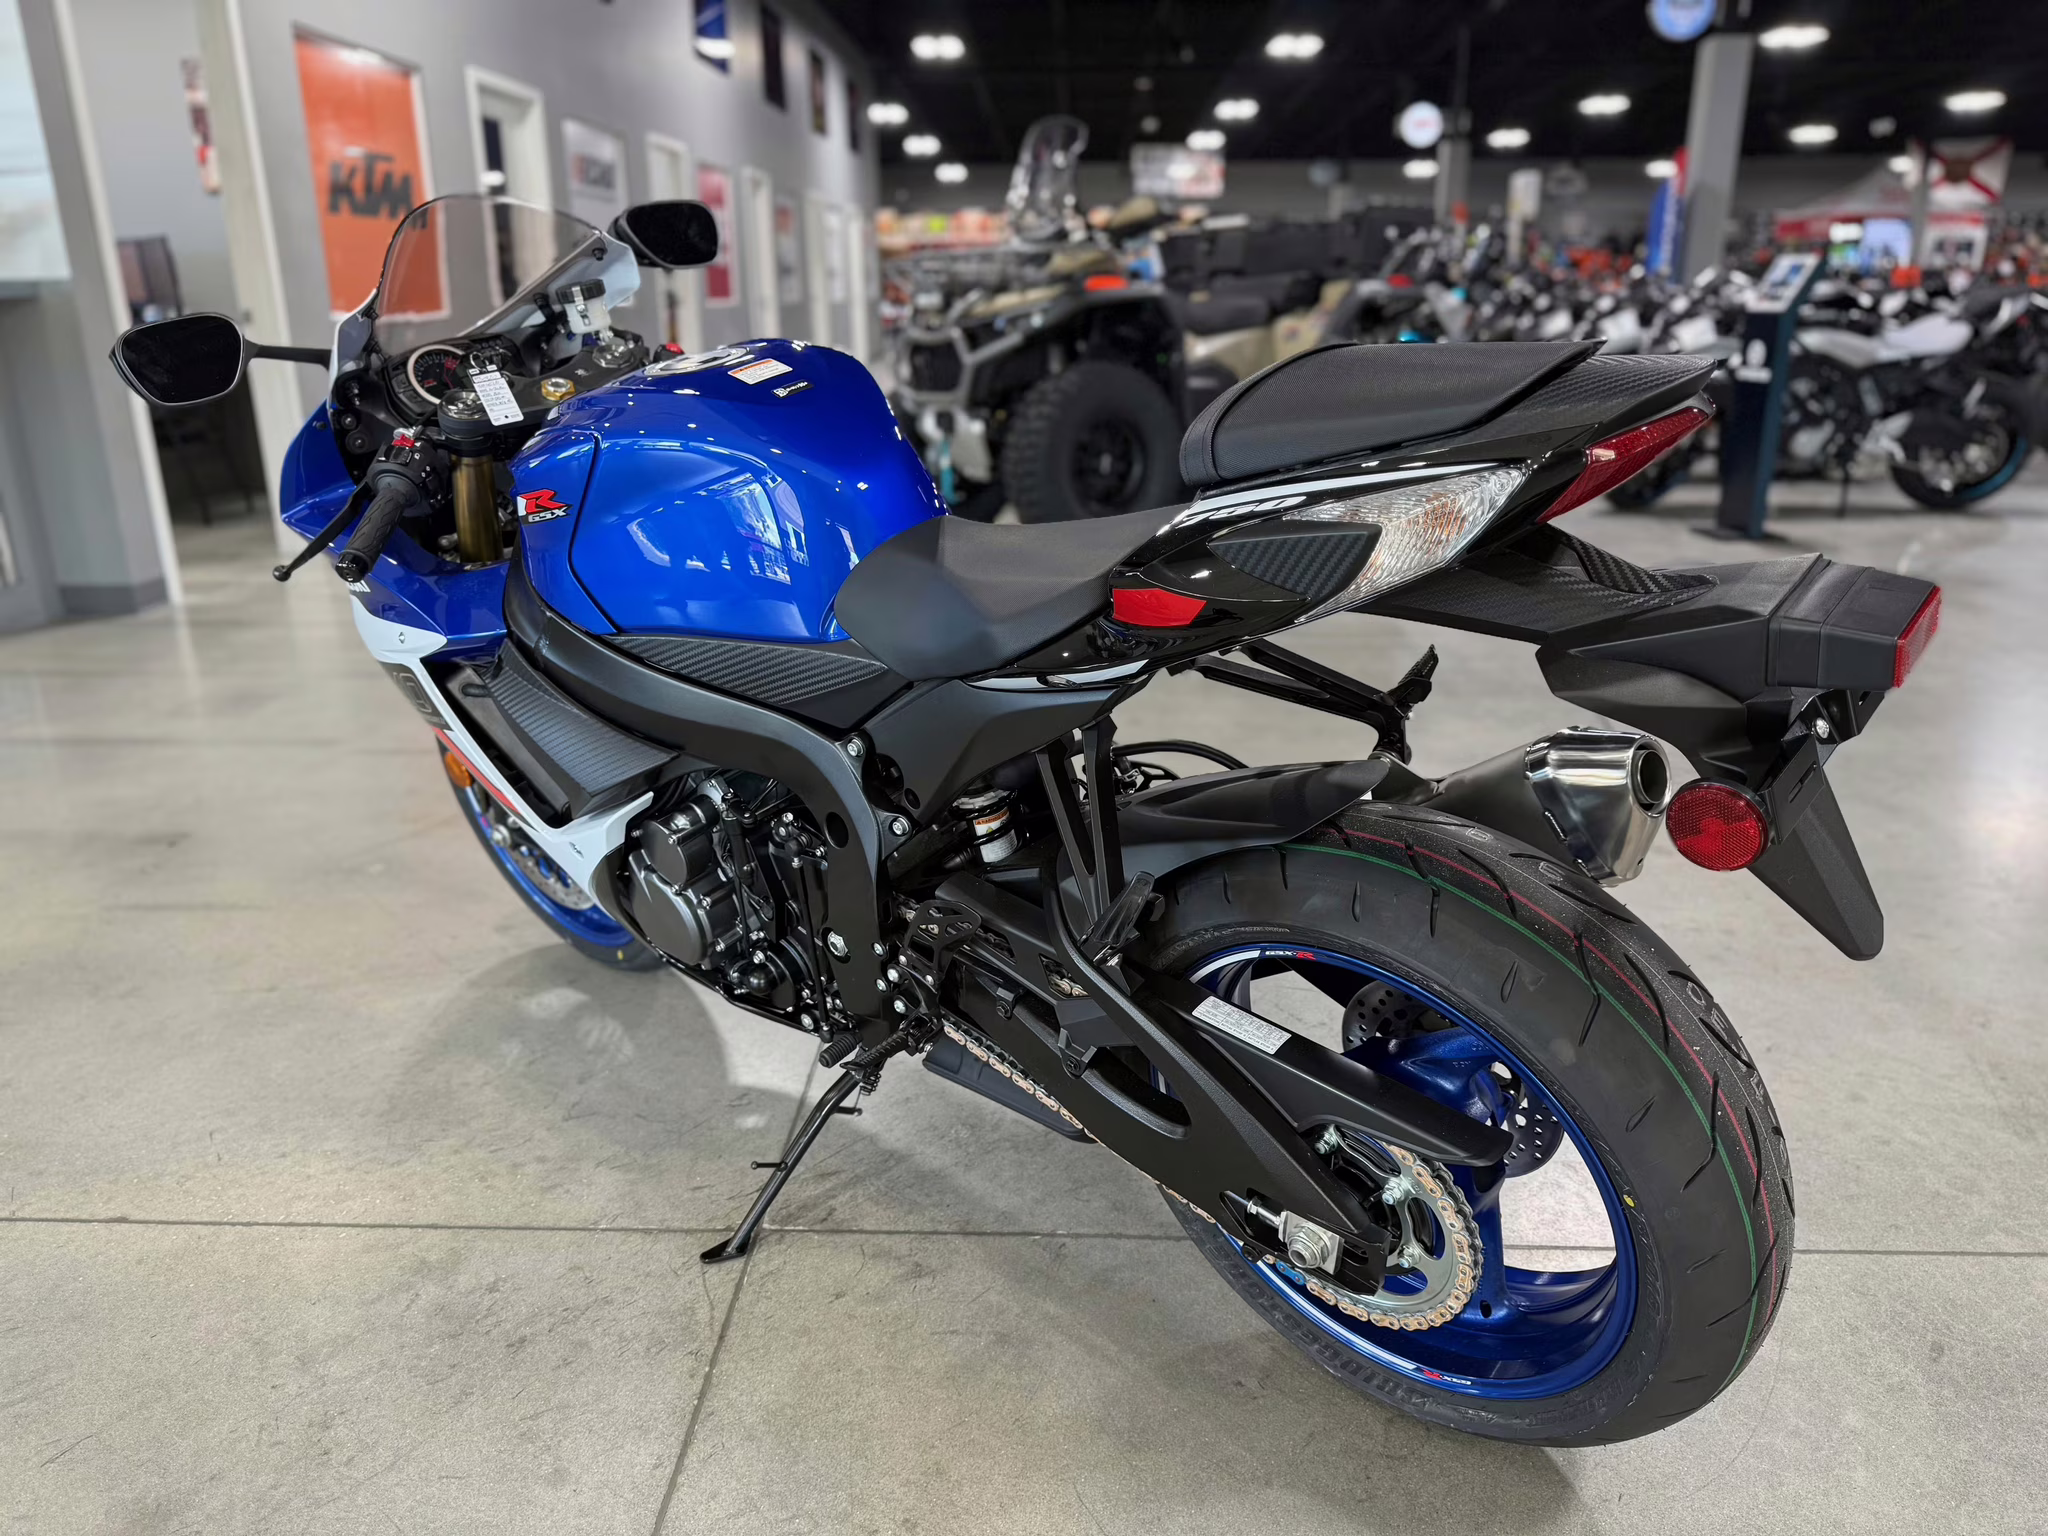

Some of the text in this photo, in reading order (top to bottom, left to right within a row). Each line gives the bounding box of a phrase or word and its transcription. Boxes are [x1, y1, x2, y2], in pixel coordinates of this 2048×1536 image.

[329, 151, 428, 229] KTM
[528, 507, 568, 522] GSX
[1175, 496, 1307, 529] 750
